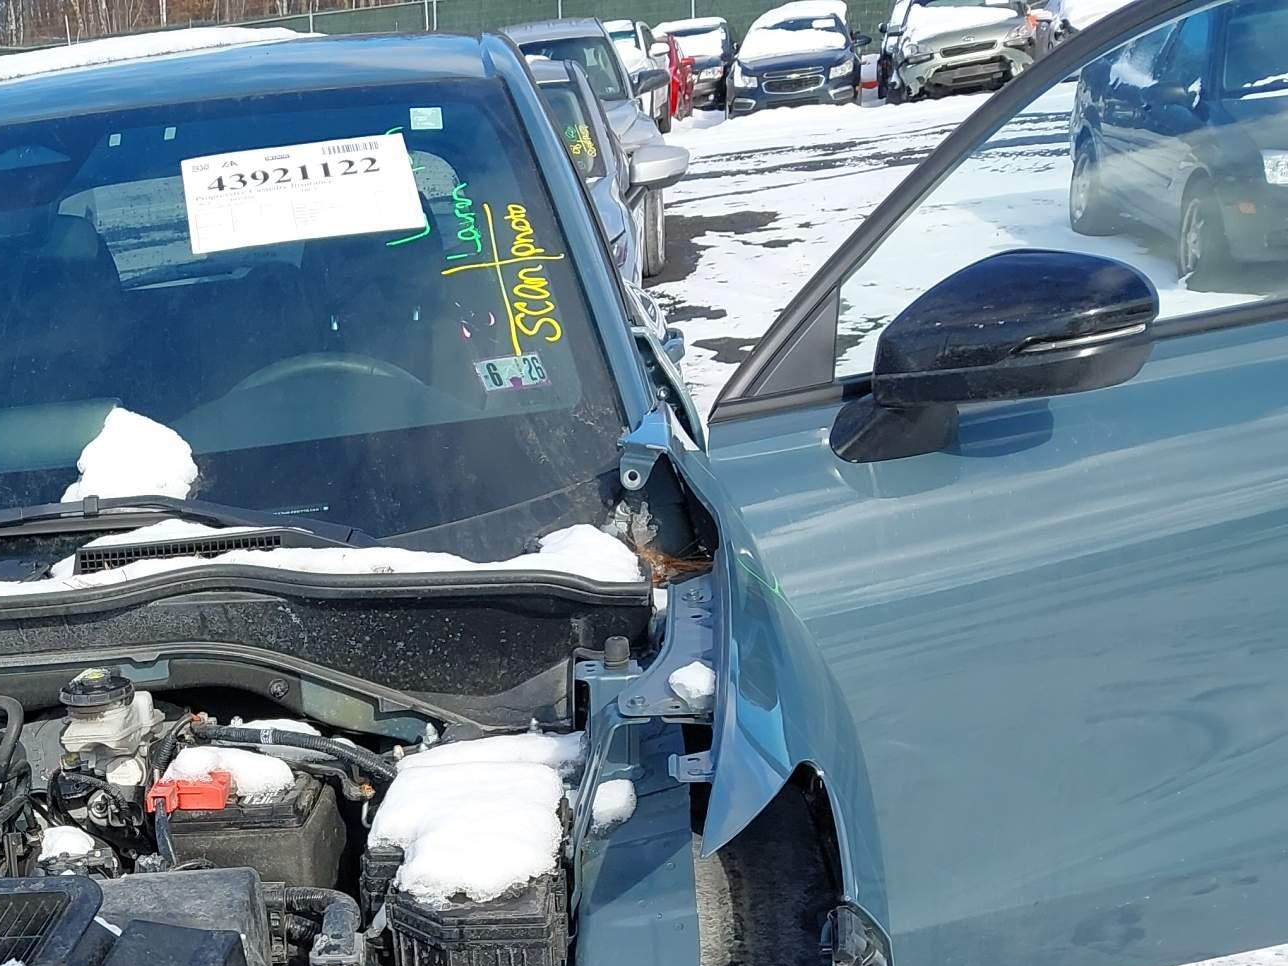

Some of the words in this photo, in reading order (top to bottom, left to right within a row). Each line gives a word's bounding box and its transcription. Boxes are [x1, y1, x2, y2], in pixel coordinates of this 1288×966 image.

[207, 156, 381, 191] 43921122
[486, 362, 504, 387] 6
[522, 356, 546, 381] 26
